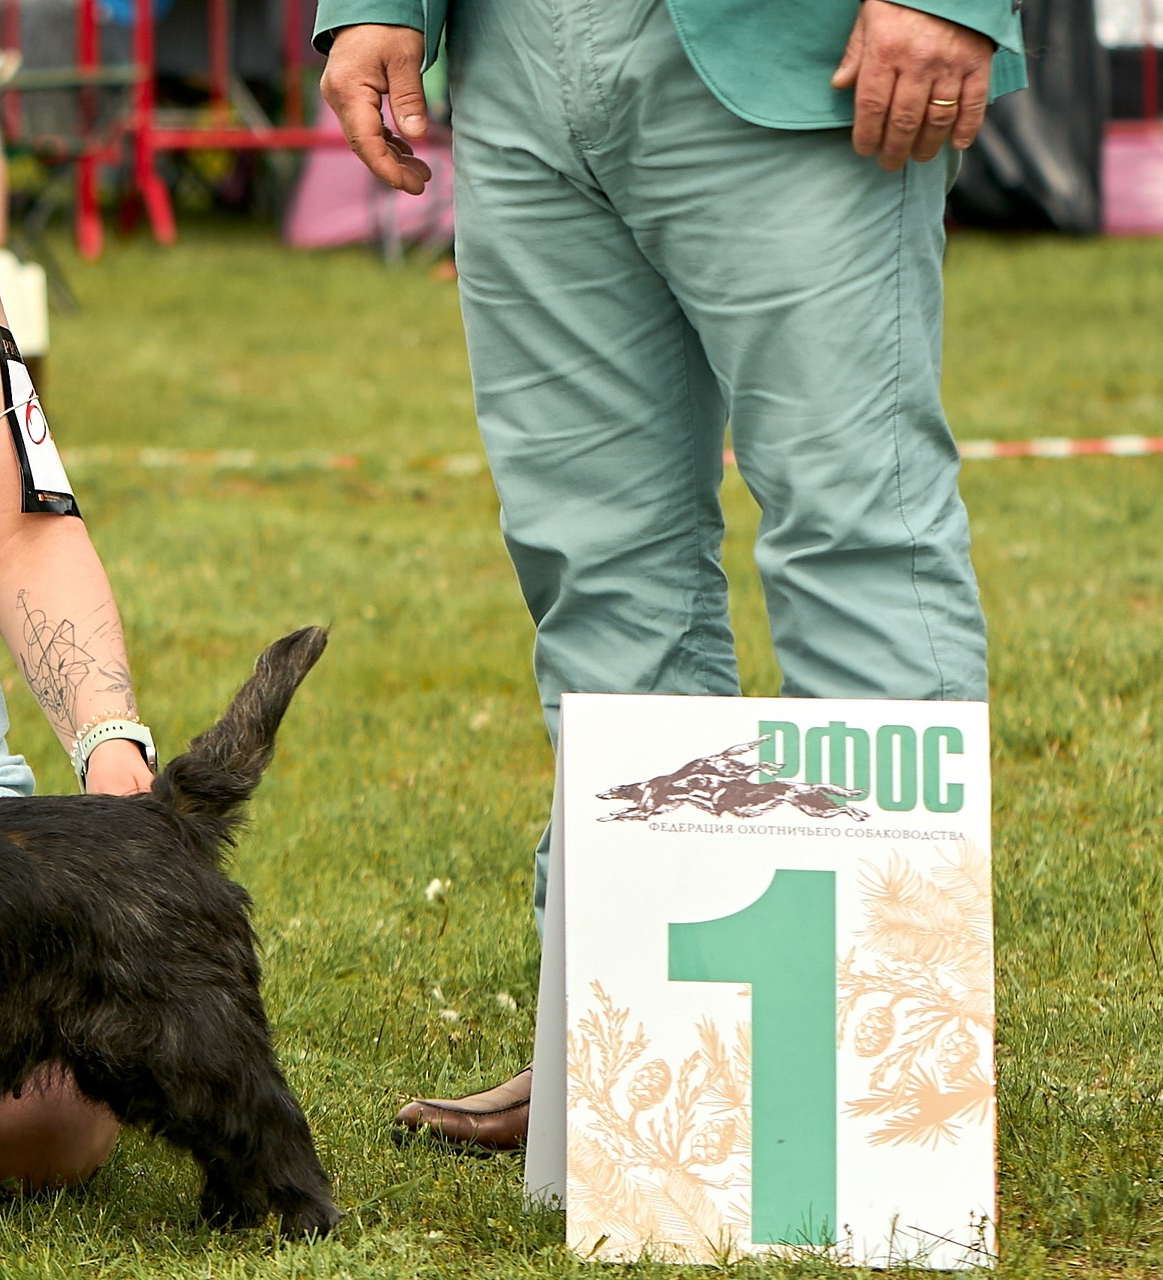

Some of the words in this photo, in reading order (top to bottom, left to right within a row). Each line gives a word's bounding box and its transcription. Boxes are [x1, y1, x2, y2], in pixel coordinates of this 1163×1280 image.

[758, 720, 964, 813] РФОС
[648, 821, 734, 834] ФЕДЕРАЦИЯ
[737, 825, 841, 838] ОХОТНИЧЬЕГО
[844, 828, 966, 841] СОБАКОВОДСТВА
[668, 869, 837, 1245] 1
